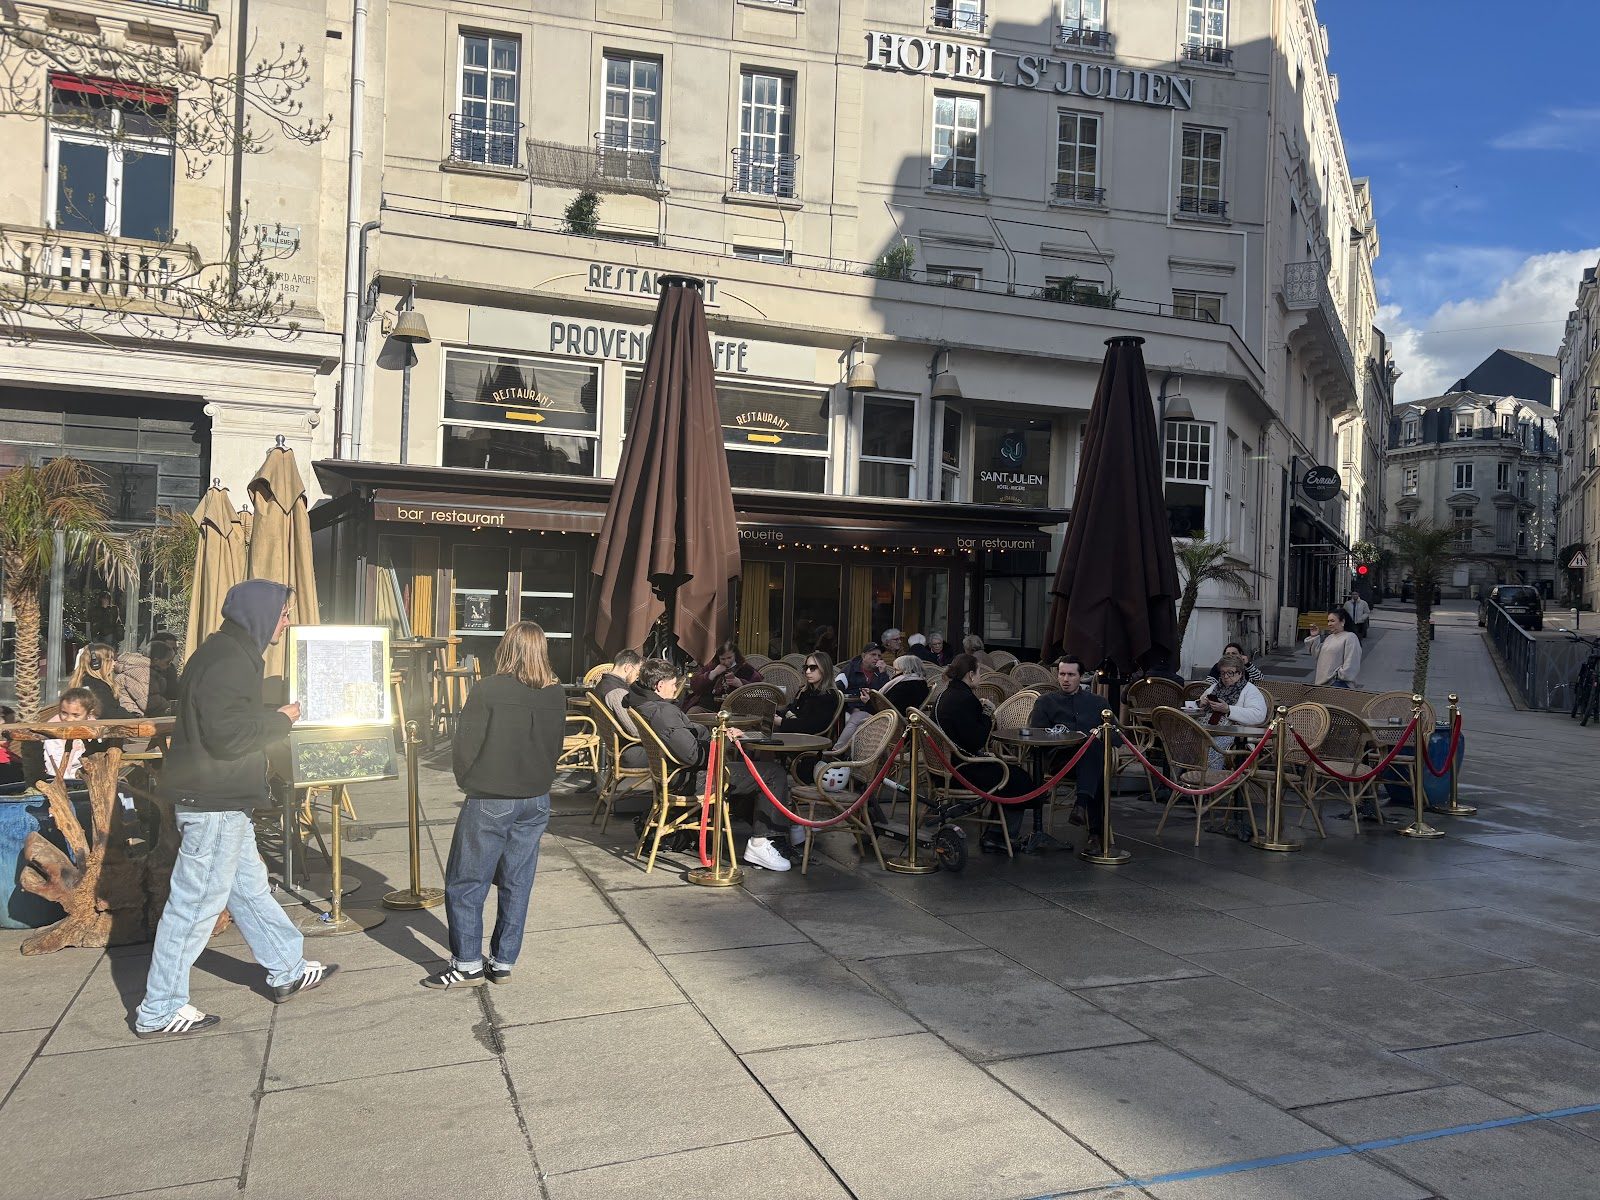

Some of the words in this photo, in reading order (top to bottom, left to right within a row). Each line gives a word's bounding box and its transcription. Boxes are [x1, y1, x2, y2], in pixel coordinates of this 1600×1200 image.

[865, 31, 1005, 84] HOTEL
[1055, 60, 1196, 110] JULIEN
[550, 321, 651, 360] PROVEN
[714, 341, 749, 373] FFÉ
[492, 387, 554, 409] RESTAURANT
[735, 411, 790, 431] RESTAURANT
[980, 471, 1008, 483] SAINT
[1009, 473, 1043, 485] JULIEN
[397, 507, 423, 521] bar
[431, 509, 505, 526] restaurant
[736, 527, 784, 541] houette
[957, 536, 976, 547] bar
[981, 538, 1036, 549] restaurant
